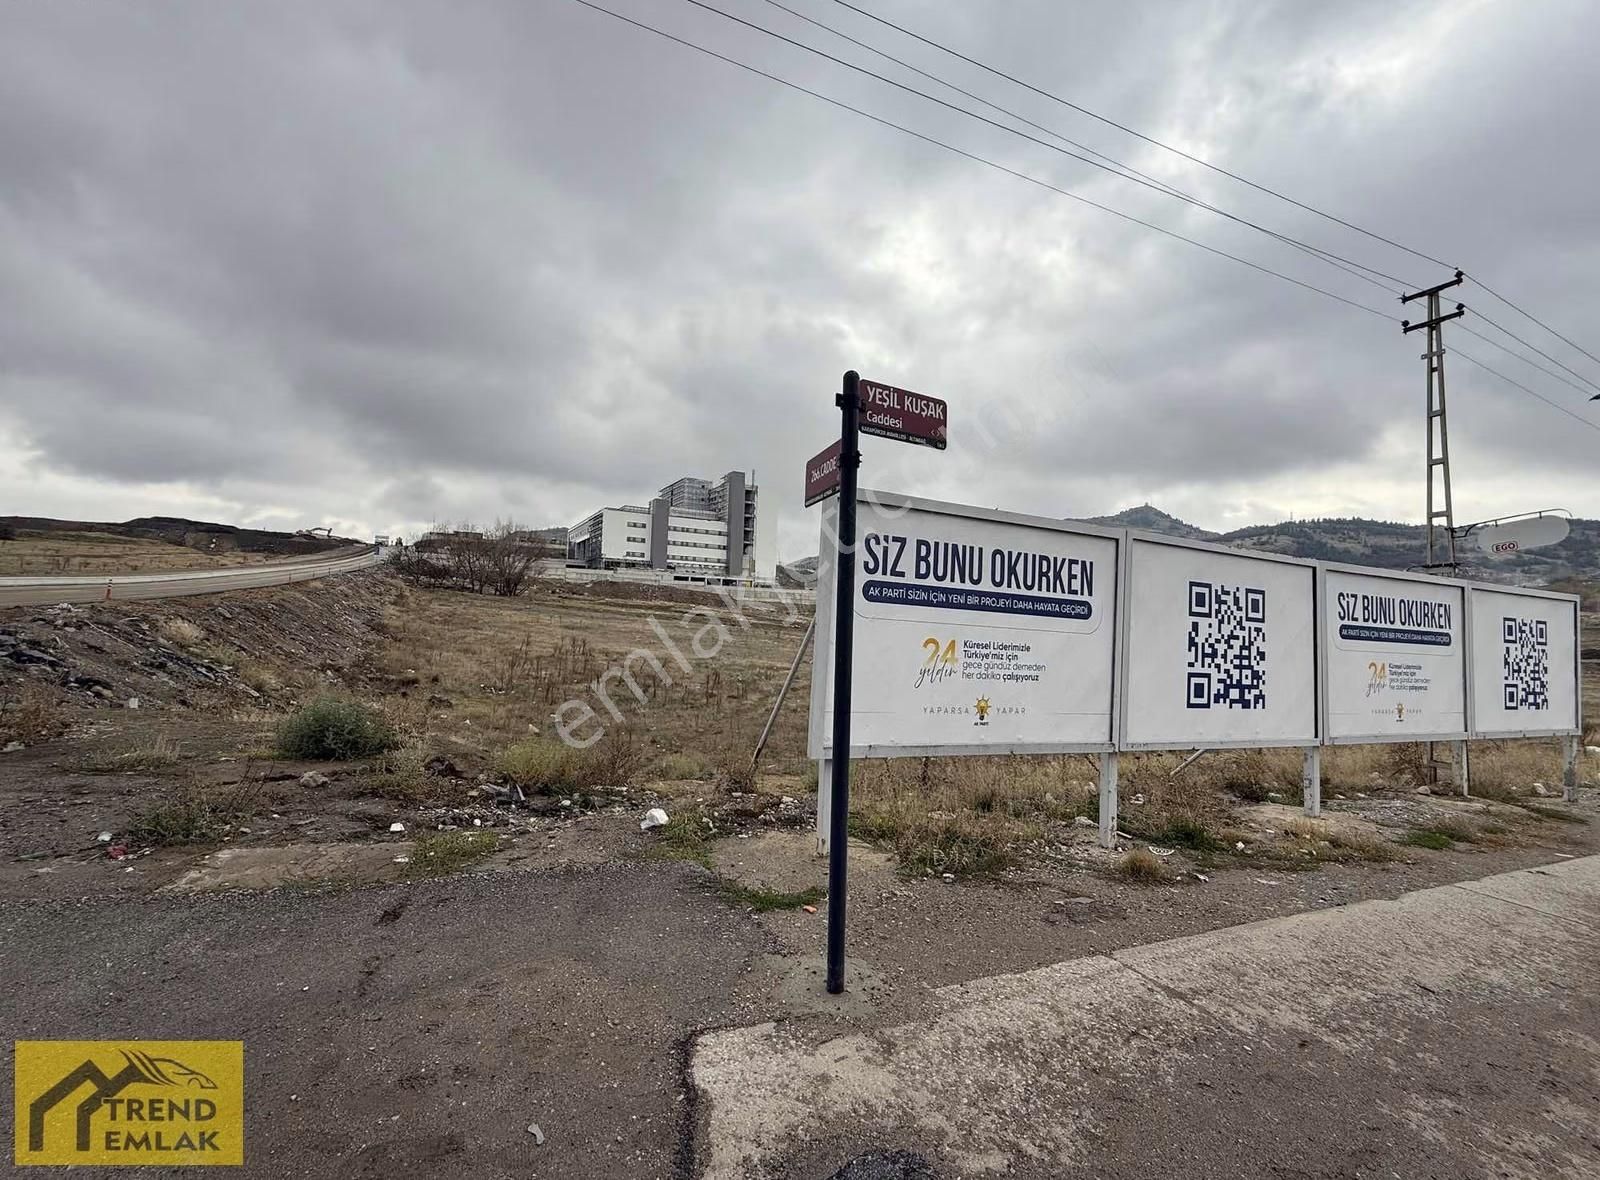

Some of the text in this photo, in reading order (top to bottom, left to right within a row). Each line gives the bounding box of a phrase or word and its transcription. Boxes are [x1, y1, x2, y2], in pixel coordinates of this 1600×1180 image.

[867, 385, 944, 420] YEŞİL KUŞAK
[866, 410, 903, 429] Caddesi
[1495, 542, 1516, 552] EGO
[915, 539, 983, 585] BUNU
[991, 549, 1093, 597] OKURKEN
[868, 587, 1088, 615] AK PARTİ SİZİN İÇİN YENİ BİR PROJEYİ DAHA HAYATA GEÇİRDİ
[1362, 594, 1396, 625] BUNU
[1399, 599, 1452, 630] OKURKEN
[922, 637, 958, 666] 24
[963, 640, 1031, 652] Küresel Liderimizle
[963, 650, 1018, 662] Türkiye'miz için
[962, 661, 1046, 672] gece gündüz demeden
[962, 671, 1039, 683] her dakika çalışıyoruz
[922, 706, 1026, 715] YAPARSA YAPAR
